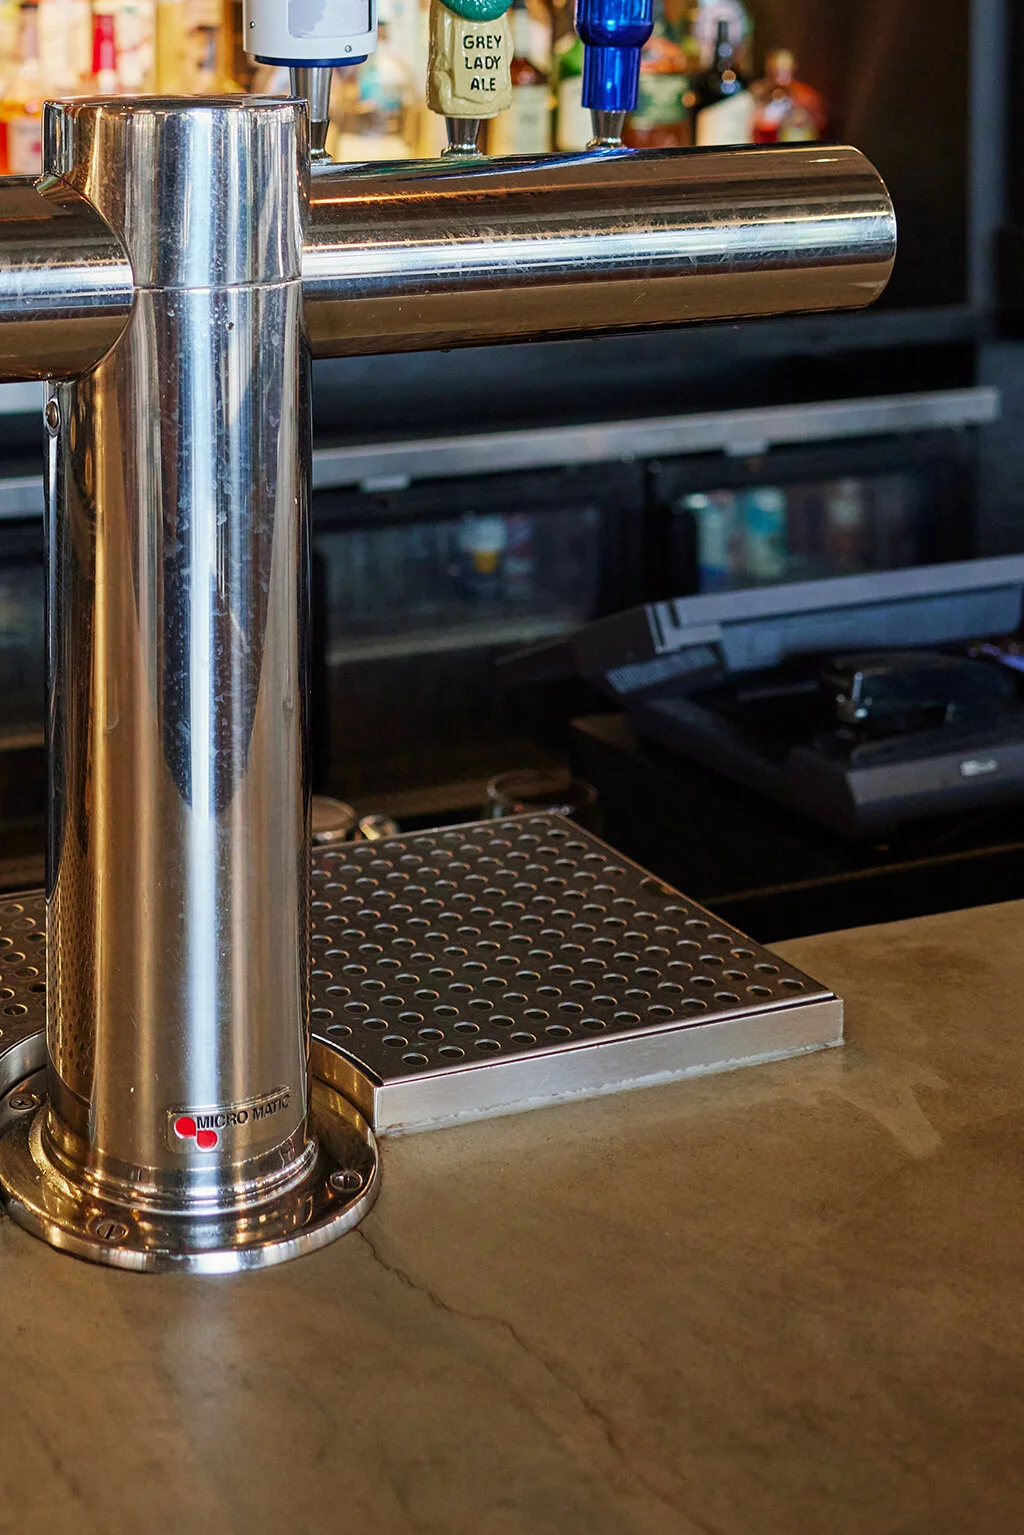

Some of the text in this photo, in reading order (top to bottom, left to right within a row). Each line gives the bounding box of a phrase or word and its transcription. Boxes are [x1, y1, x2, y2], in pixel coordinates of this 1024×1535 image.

[462, 34, 502, 50] GREY
[464, 55, 502, 70] LADY
[470, 77, 496, 92] ALE
[196, 1094, 291, 1130] MICRO MATIC
